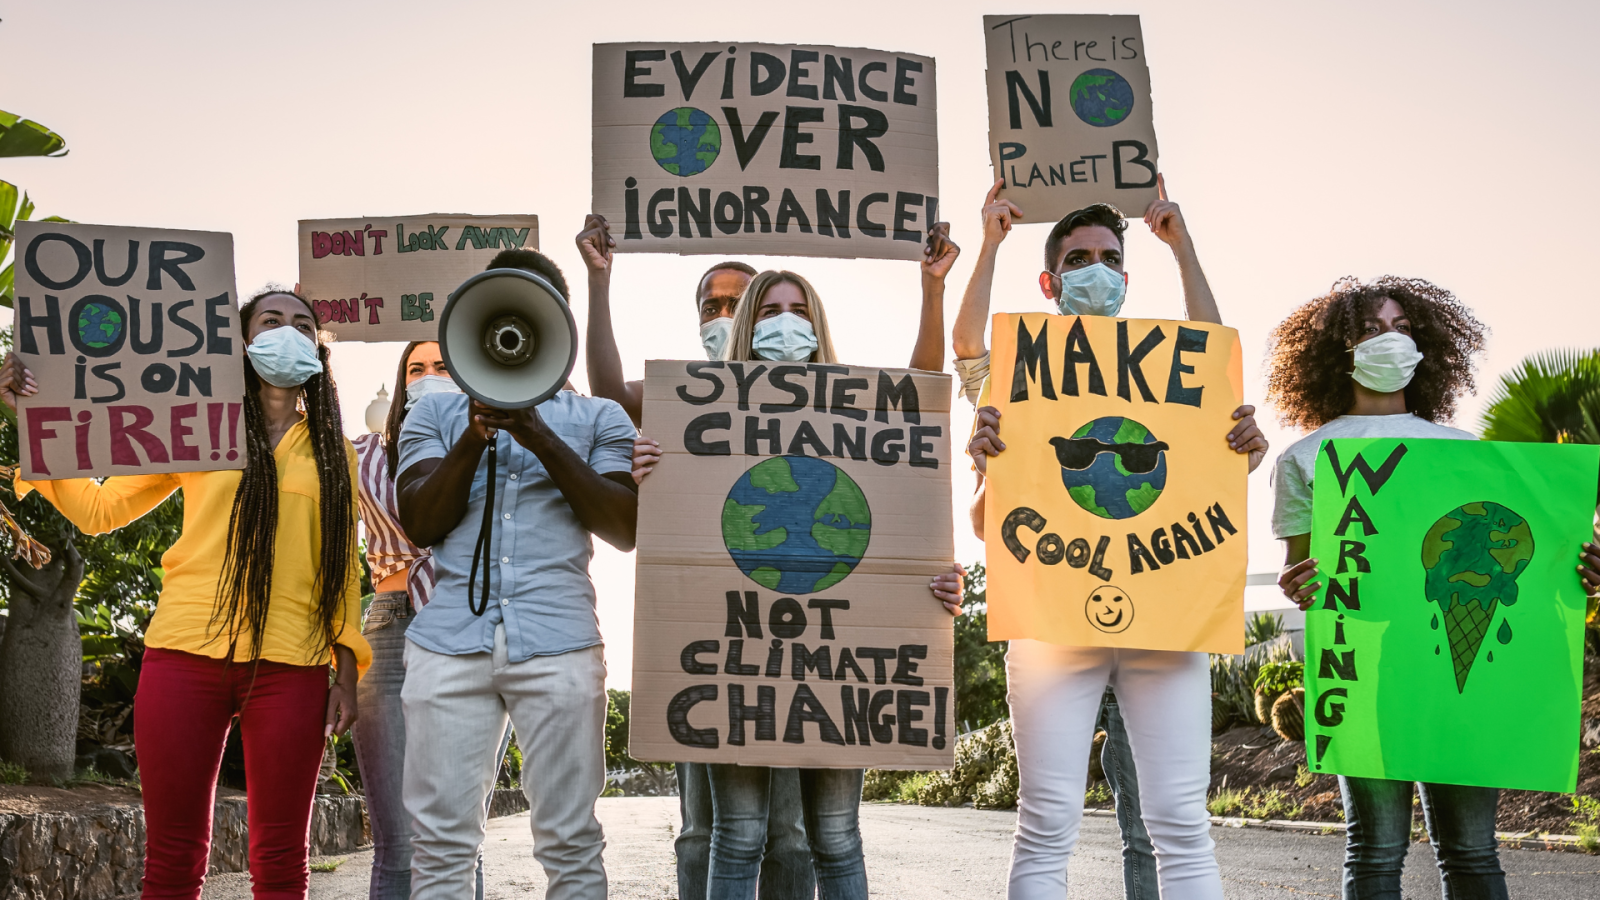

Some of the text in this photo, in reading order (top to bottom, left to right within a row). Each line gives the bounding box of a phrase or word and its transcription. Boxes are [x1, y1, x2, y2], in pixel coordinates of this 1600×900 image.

[998, 140, 1158, 189] PLANET B
[24, 232, 206, 291] OUR
[311, 224, 388, 259] DON'T
[456, 225, 530, 250] AWAY
[18, 291, 233, 358] HOUSE
[400, 292, 434, 323] BE
[140, 361, 213, 397] ON
[1010, 316, 1209, 408] MAKE
[675, 360, 921, 425] SYSTEM
[683, 411, 942, 470] CHANGE
[1001, 506, 1113, 582] COOL
[724, 590, 850, 640] NOT
[666, 683, 949, 750] CHANGE!
